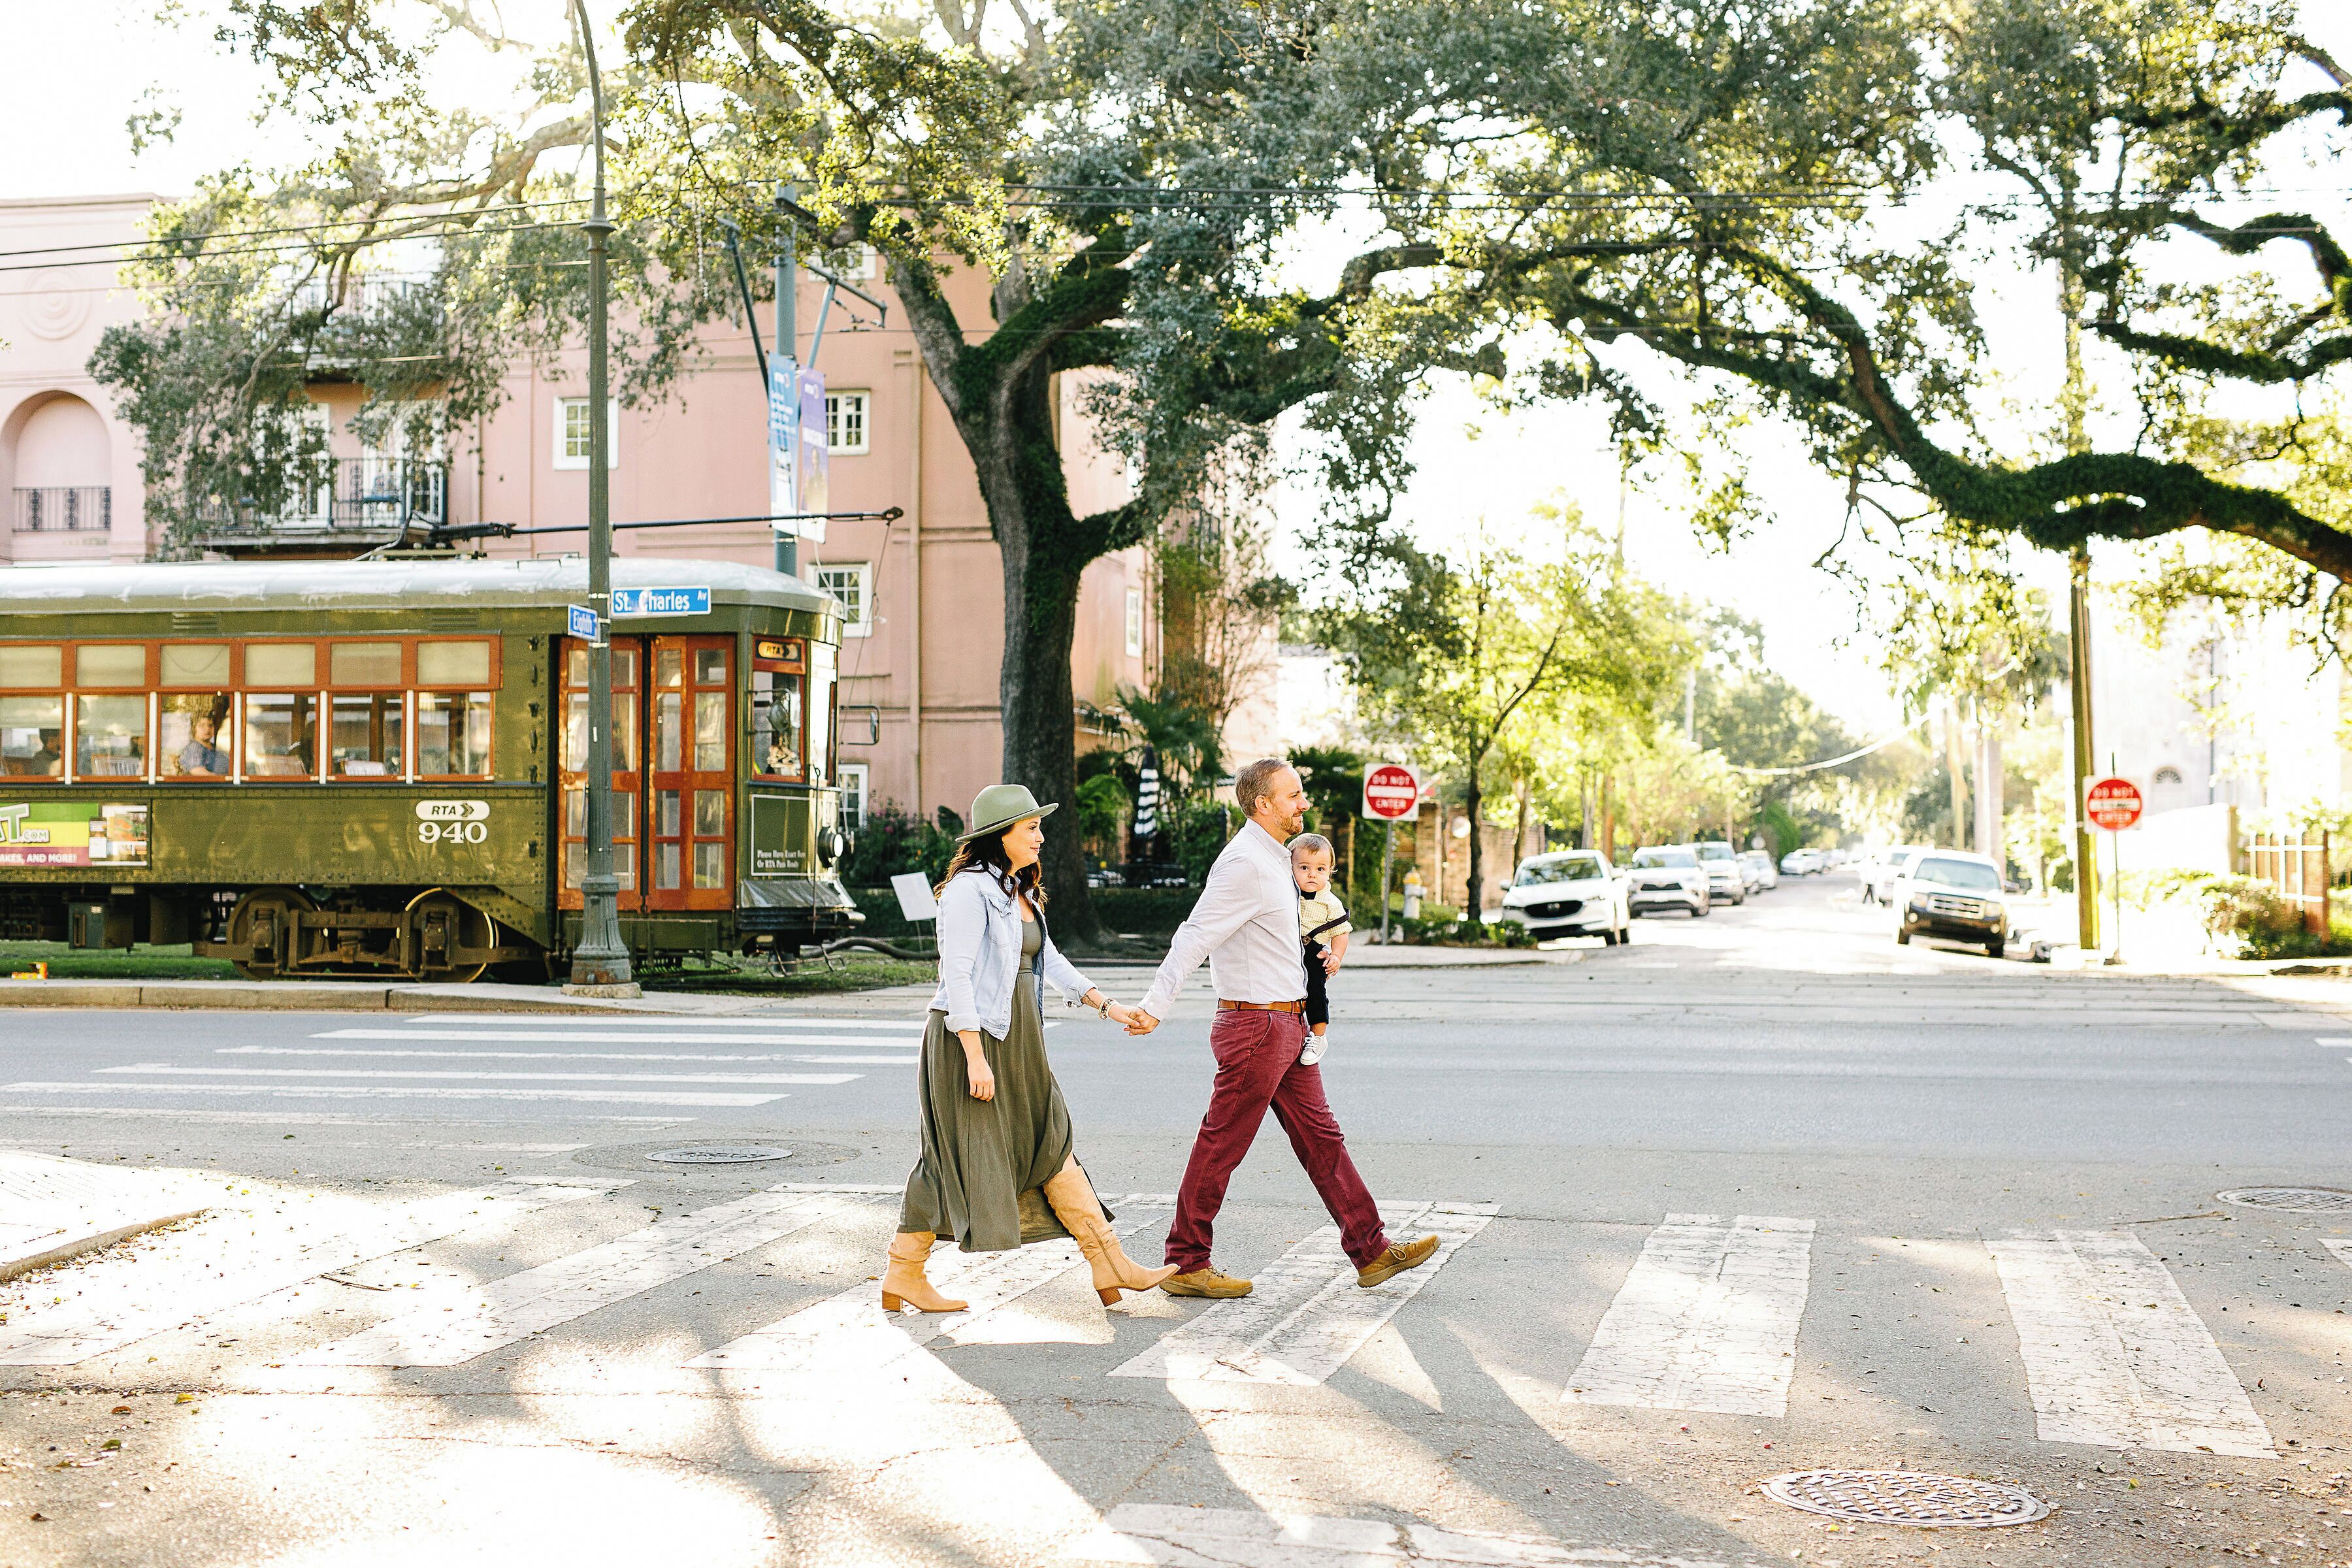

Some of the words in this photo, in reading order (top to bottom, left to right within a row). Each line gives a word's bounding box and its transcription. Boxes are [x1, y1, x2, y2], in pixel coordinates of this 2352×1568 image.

[615, 591, 632, 612] St.
[638, 590, 690, 611] Charles
[1372, 774, 1388, 785] DO
[1390, 776, 1411, 786] NOT
[2093, 787, 2110, 798] DO
[2112, 787, 2134, 798] NOT
[1375, 798, 1407, 809] ENTER
[431, 806, 457, 815] RTA
[2097, 812, 2132, 823] ENTER
[418, 821, 488, 844] 940
[27, 853, 47, 863] AND
[48, 853, 77, 863] MORE!
